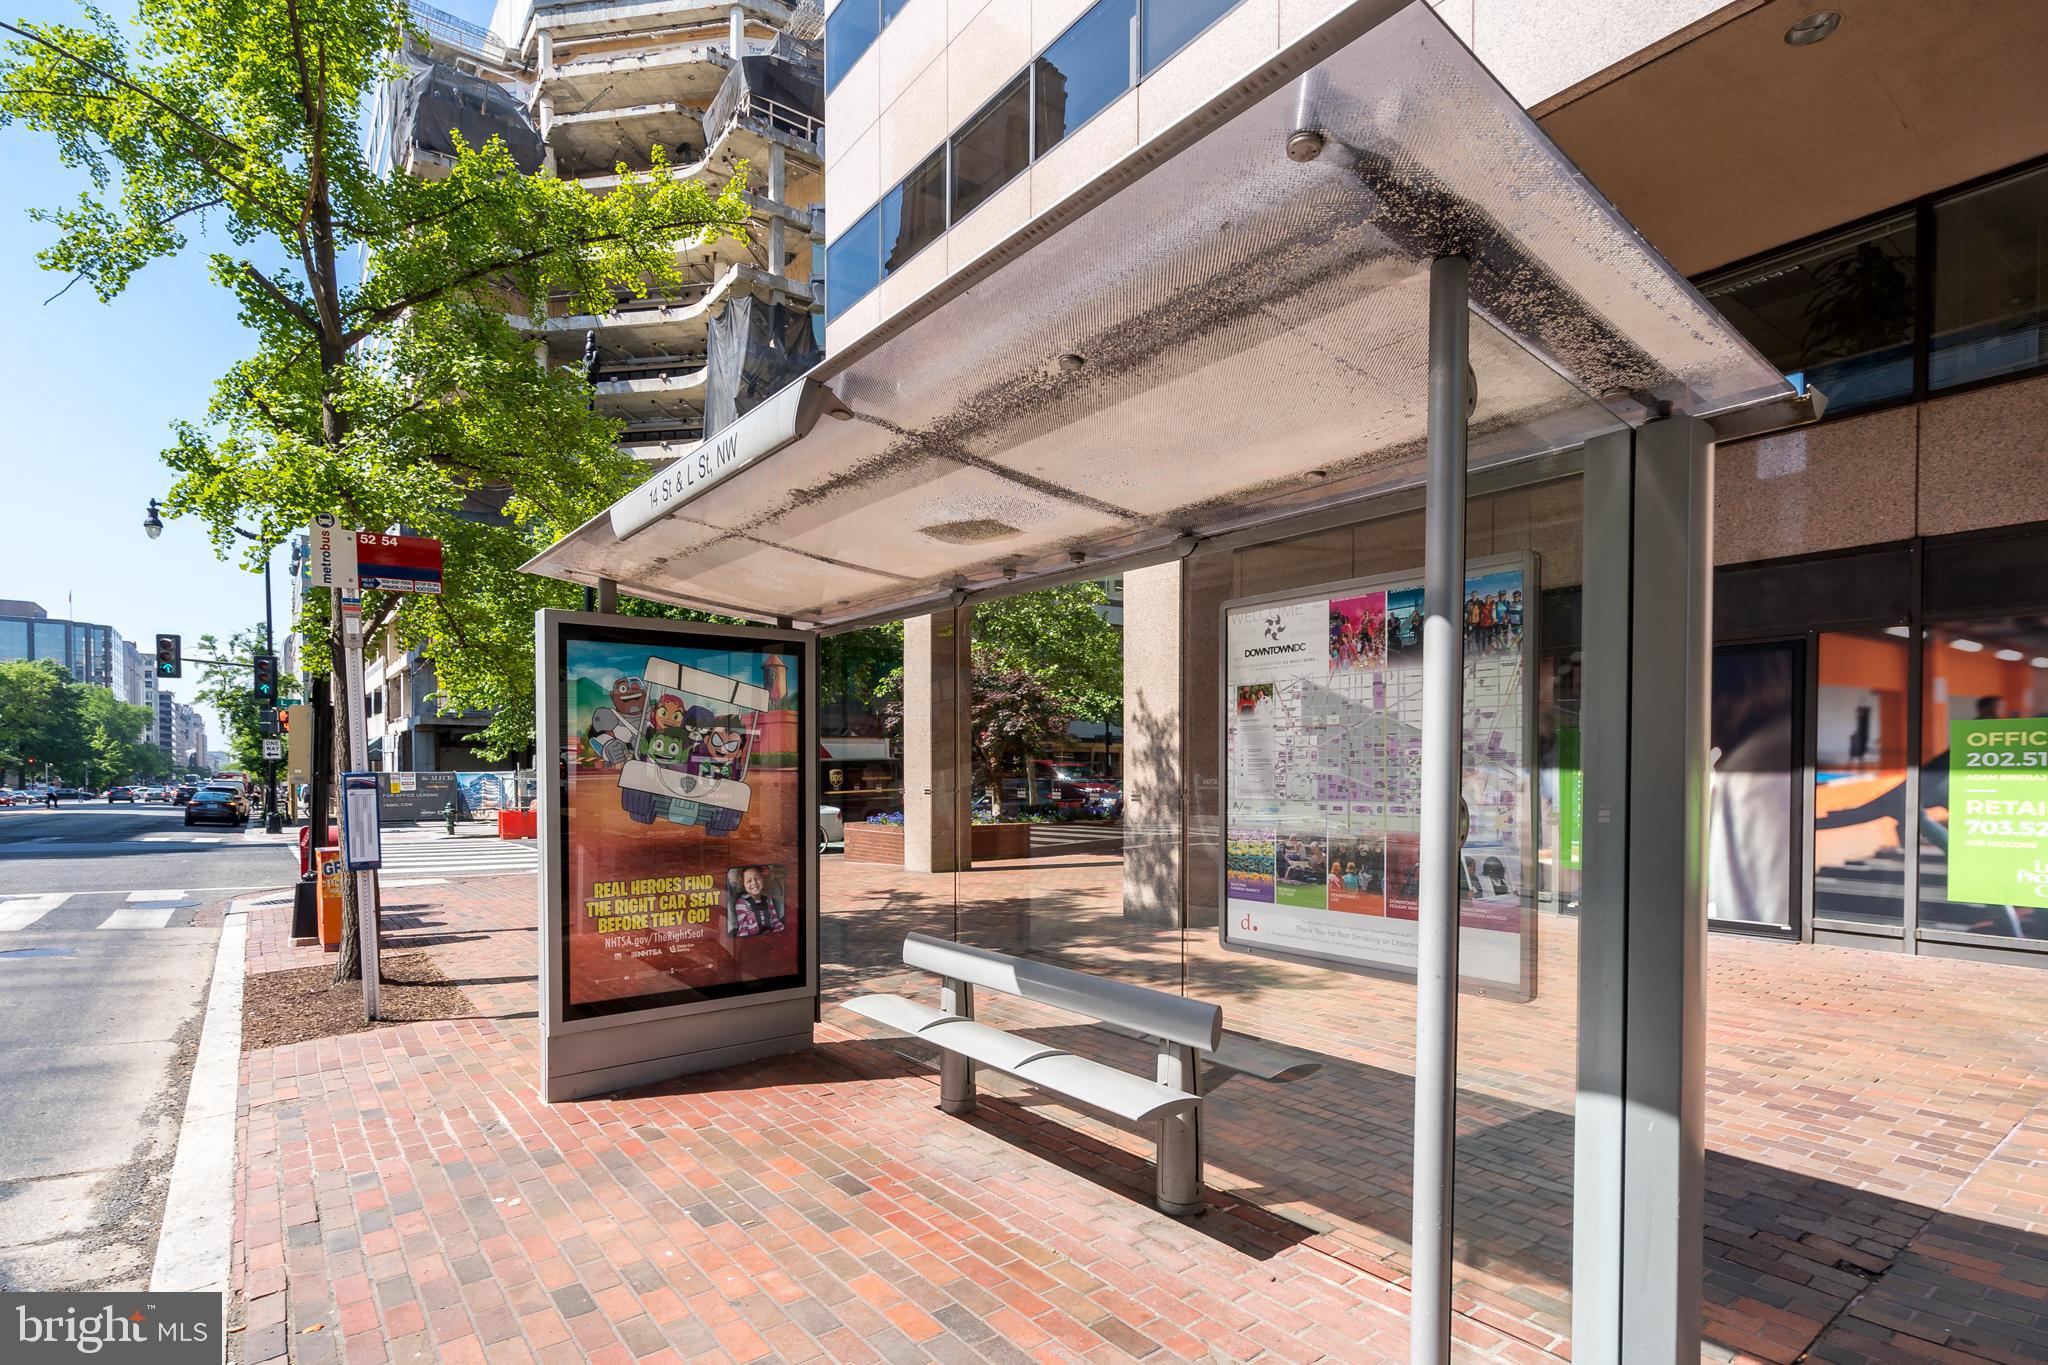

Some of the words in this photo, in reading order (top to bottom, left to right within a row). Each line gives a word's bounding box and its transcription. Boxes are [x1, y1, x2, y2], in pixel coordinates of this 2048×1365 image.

[649, 487, 658, 509] 14
[662, 478, 672, 501] St
[676, 470, 683, 493] &
[687, 464, 694, 486] L
[698, 453, 713, 477] St,
[716, 432, 738, 467] NW
[360, 535, 376, 545] 52
[381, 537, 398, 546] 54
[320, 530, 332, 584] metrobus
[1232, 606, 1304, 624] WELCOME
[1967, 731, 2048, 747] OFFIC
[593, 881, 629, 898] REAL
[630, 877, 682, 896] HEROES
[684, 874, 714, 891] FIND
[586, 901, 612, 918] THE
[614, 896, 657, 915] RIGHT
[659, 893, 687, 911] CAR
[689, 890, 721, 908] SEAT
[598, 914, 649, 934] BEFORE
[651, 910, 685, 928] THEY
[687, 908, 711, 924] GO!
[604, 929, 704, 949] NHTSA.gov/TheRightSeat
[1295, 925, 1313, 933] Thank
[1314, 926, 1326, 935] You
[1327, 928, 1337, 937] for
[1338, 930, 1351, 939] Not
[1352, 932, 1381, 945] Smoking
[637, 948, 663, 957] NHTSA
